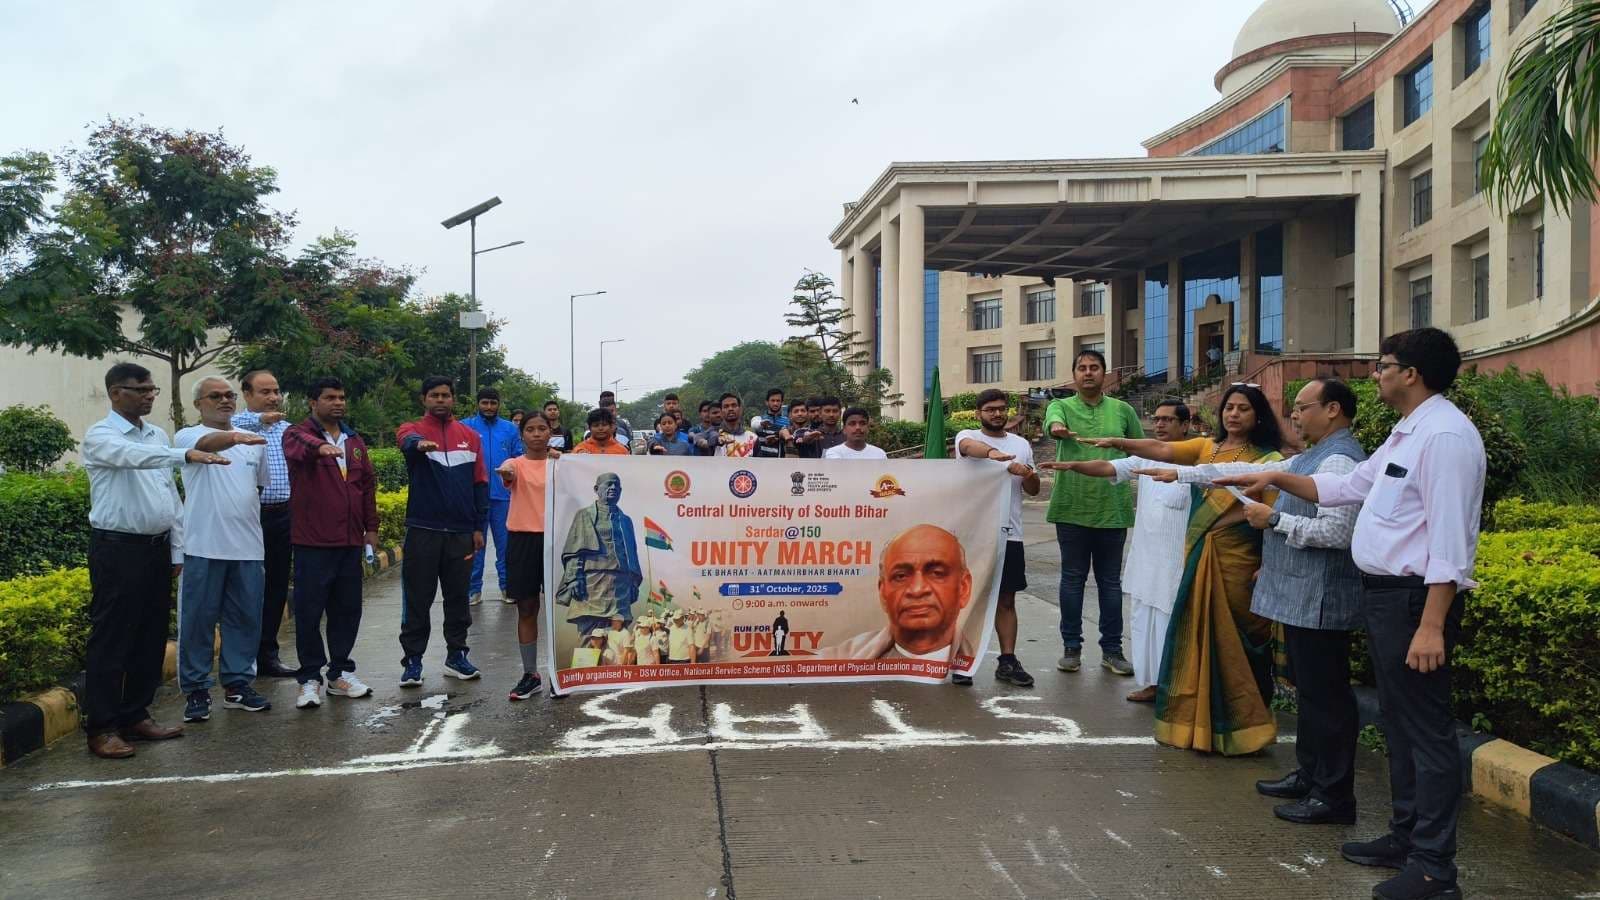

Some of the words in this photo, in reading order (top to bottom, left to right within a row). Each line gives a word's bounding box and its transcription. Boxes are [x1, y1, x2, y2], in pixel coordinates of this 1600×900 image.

[677, 504, 724, 517] Central
[729, 504, 794, 520] University
[798, 504, 810, 518] of
[815, 504, 850, 518] South
[855, 505, 889, 518] Bihar
[745, 526, 821, 539] Sardar@150
[691, 541, 769, 566] UNITY
[777, 541, 872, 566] MARCH
[757, 568, 825, 576] AATMANIRBHAR
[827, 568, 860, 576] BHARAT
[750, 584, 764, 593] 31st
[766, 585, 804, 594] October,
[806, 585, 828, 593] 2025
[745, 600, 765, 608] 9:00
[790, 599, 829, 607] onwards
[562, 672, 584, 683] Jointly
[586, 670, 621, 681] organised
[623, 670, 633, 679] by
[640, 668, 657, 677] DSW
[683, 667, 714, 676] National
[715, 666, 741, 675] Service
[743, 665, 771, 674] Scheme
[797, 663, 837, 674] Department
[847, 662, 876, 672] Physical
[877, 662, 910, 671] Education
[926, 664, 948, 674] Sports
